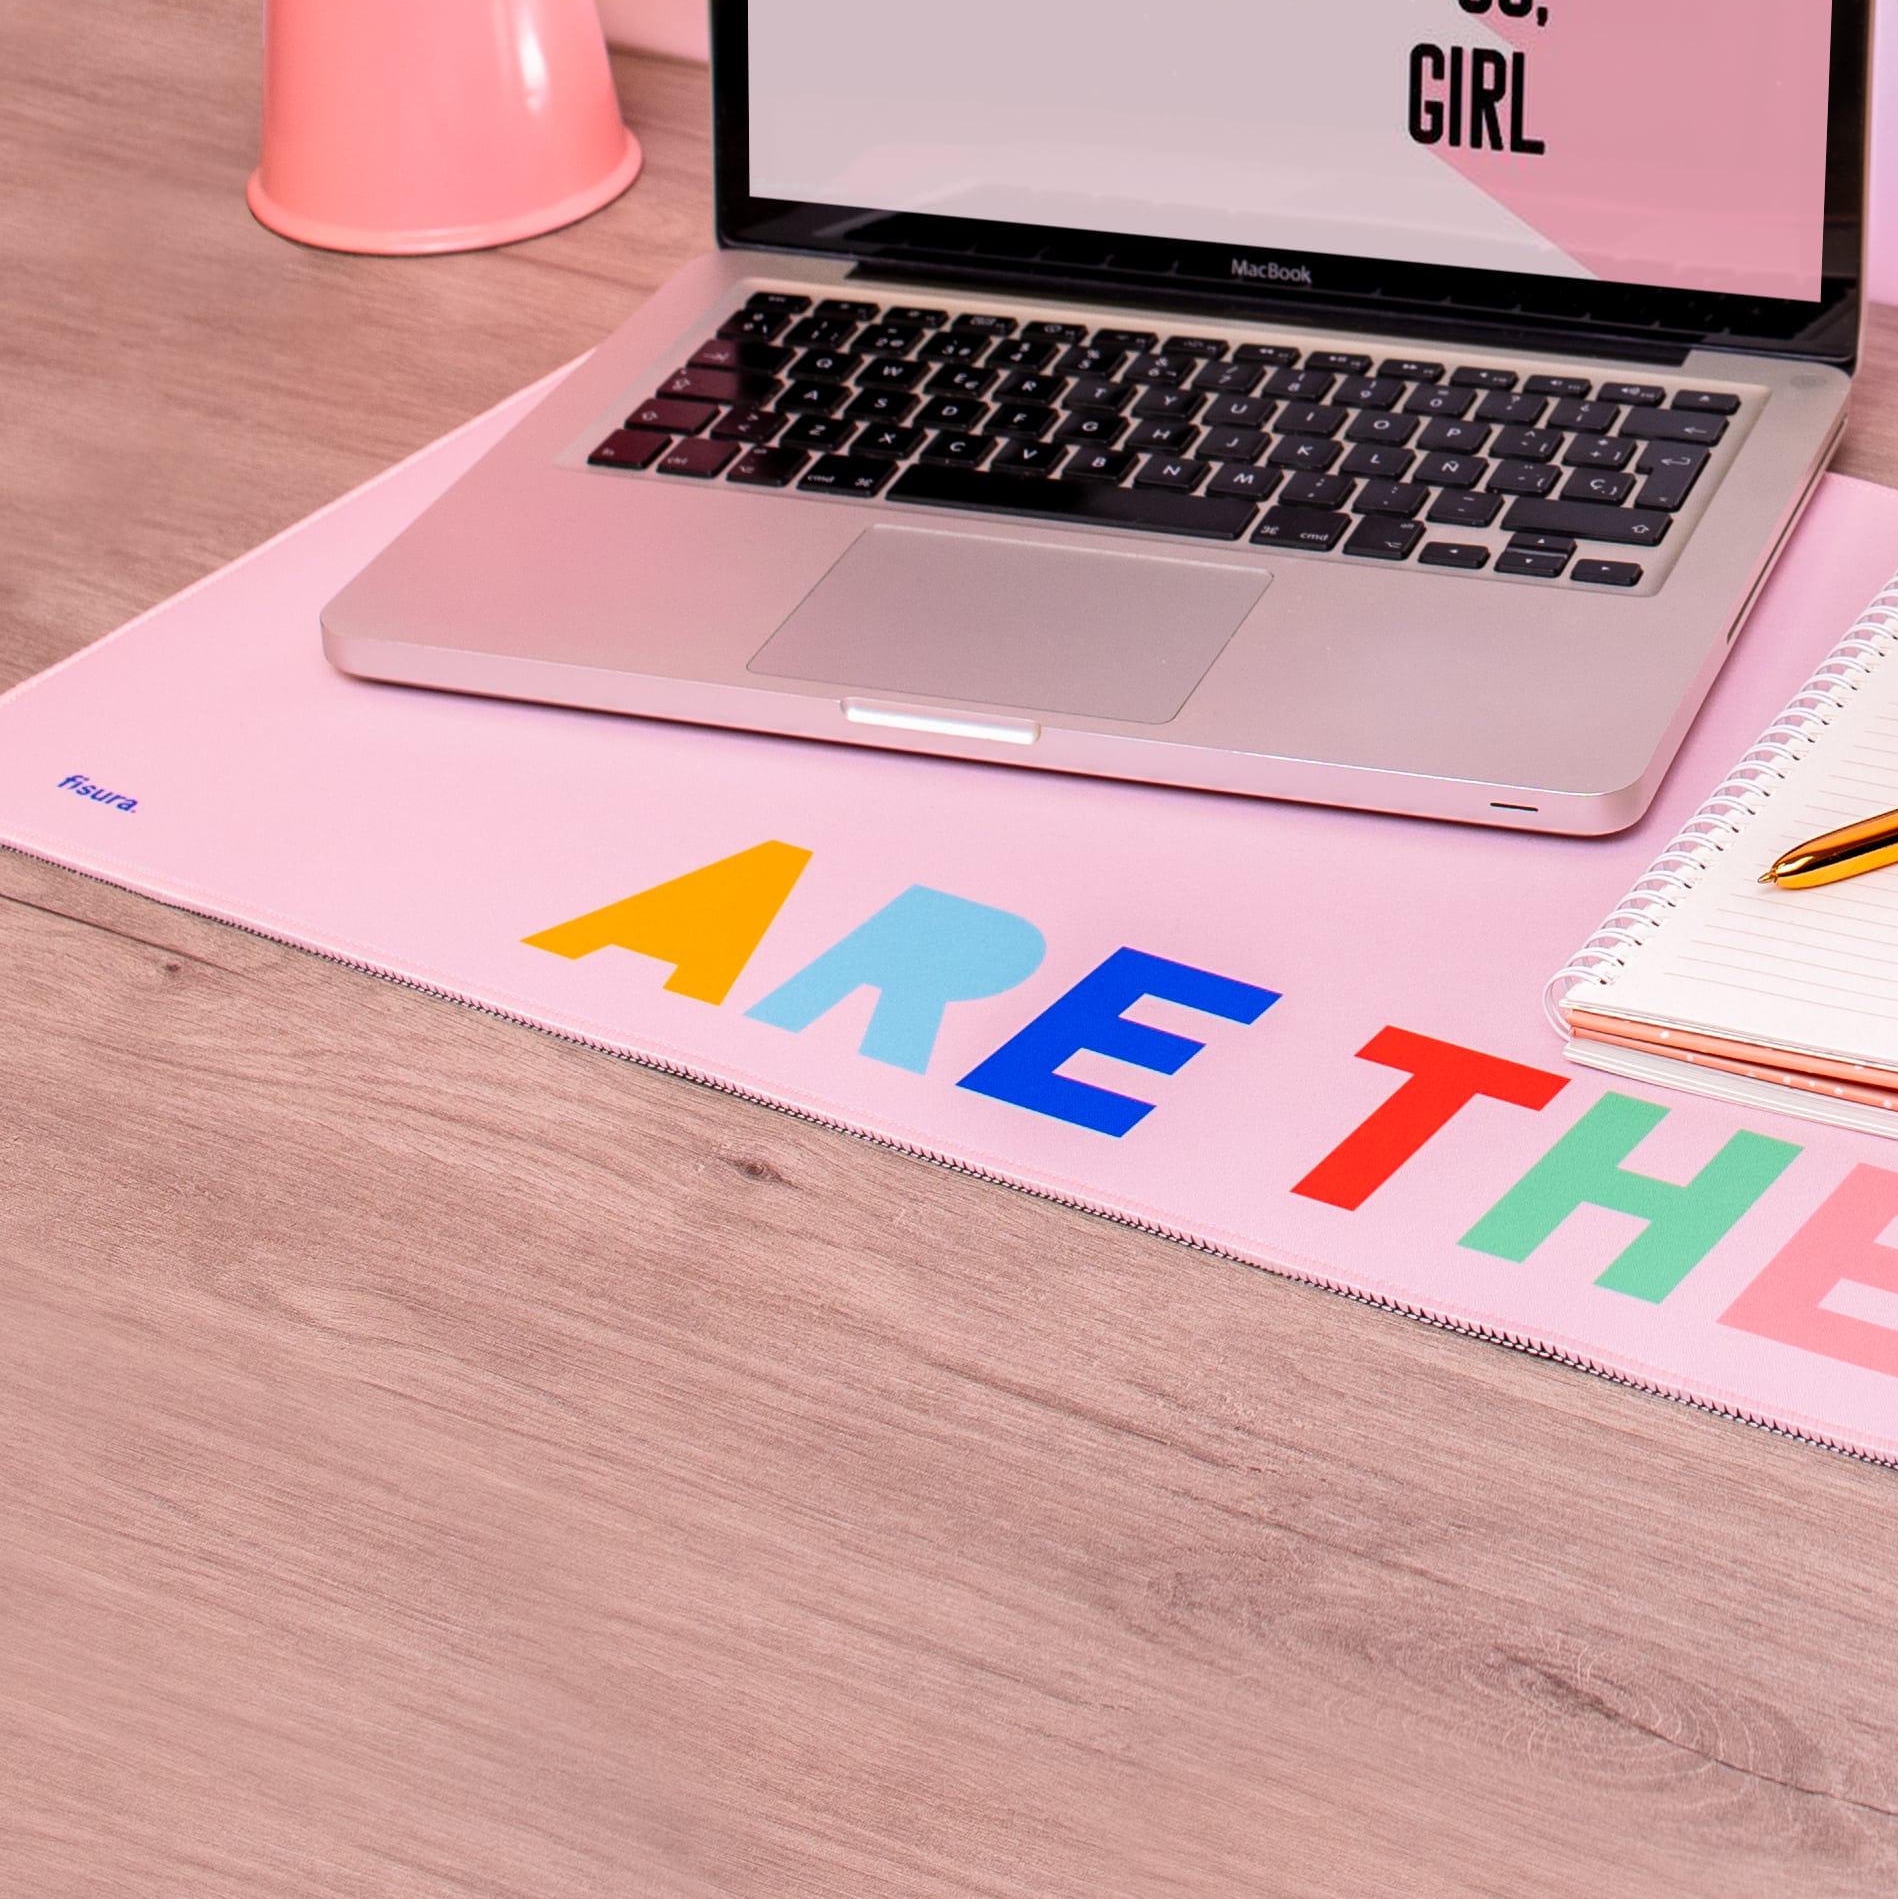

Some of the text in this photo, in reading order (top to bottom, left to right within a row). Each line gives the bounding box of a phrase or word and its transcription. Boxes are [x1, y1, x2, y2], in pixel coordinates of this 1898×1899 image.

[1408, 43, 1545, 155] GIRL
[1231, 258, 1312, 284] MacBook
[1299, 532, 1329, 541] cmd
[519, 839, 1282, 1138] ARE
